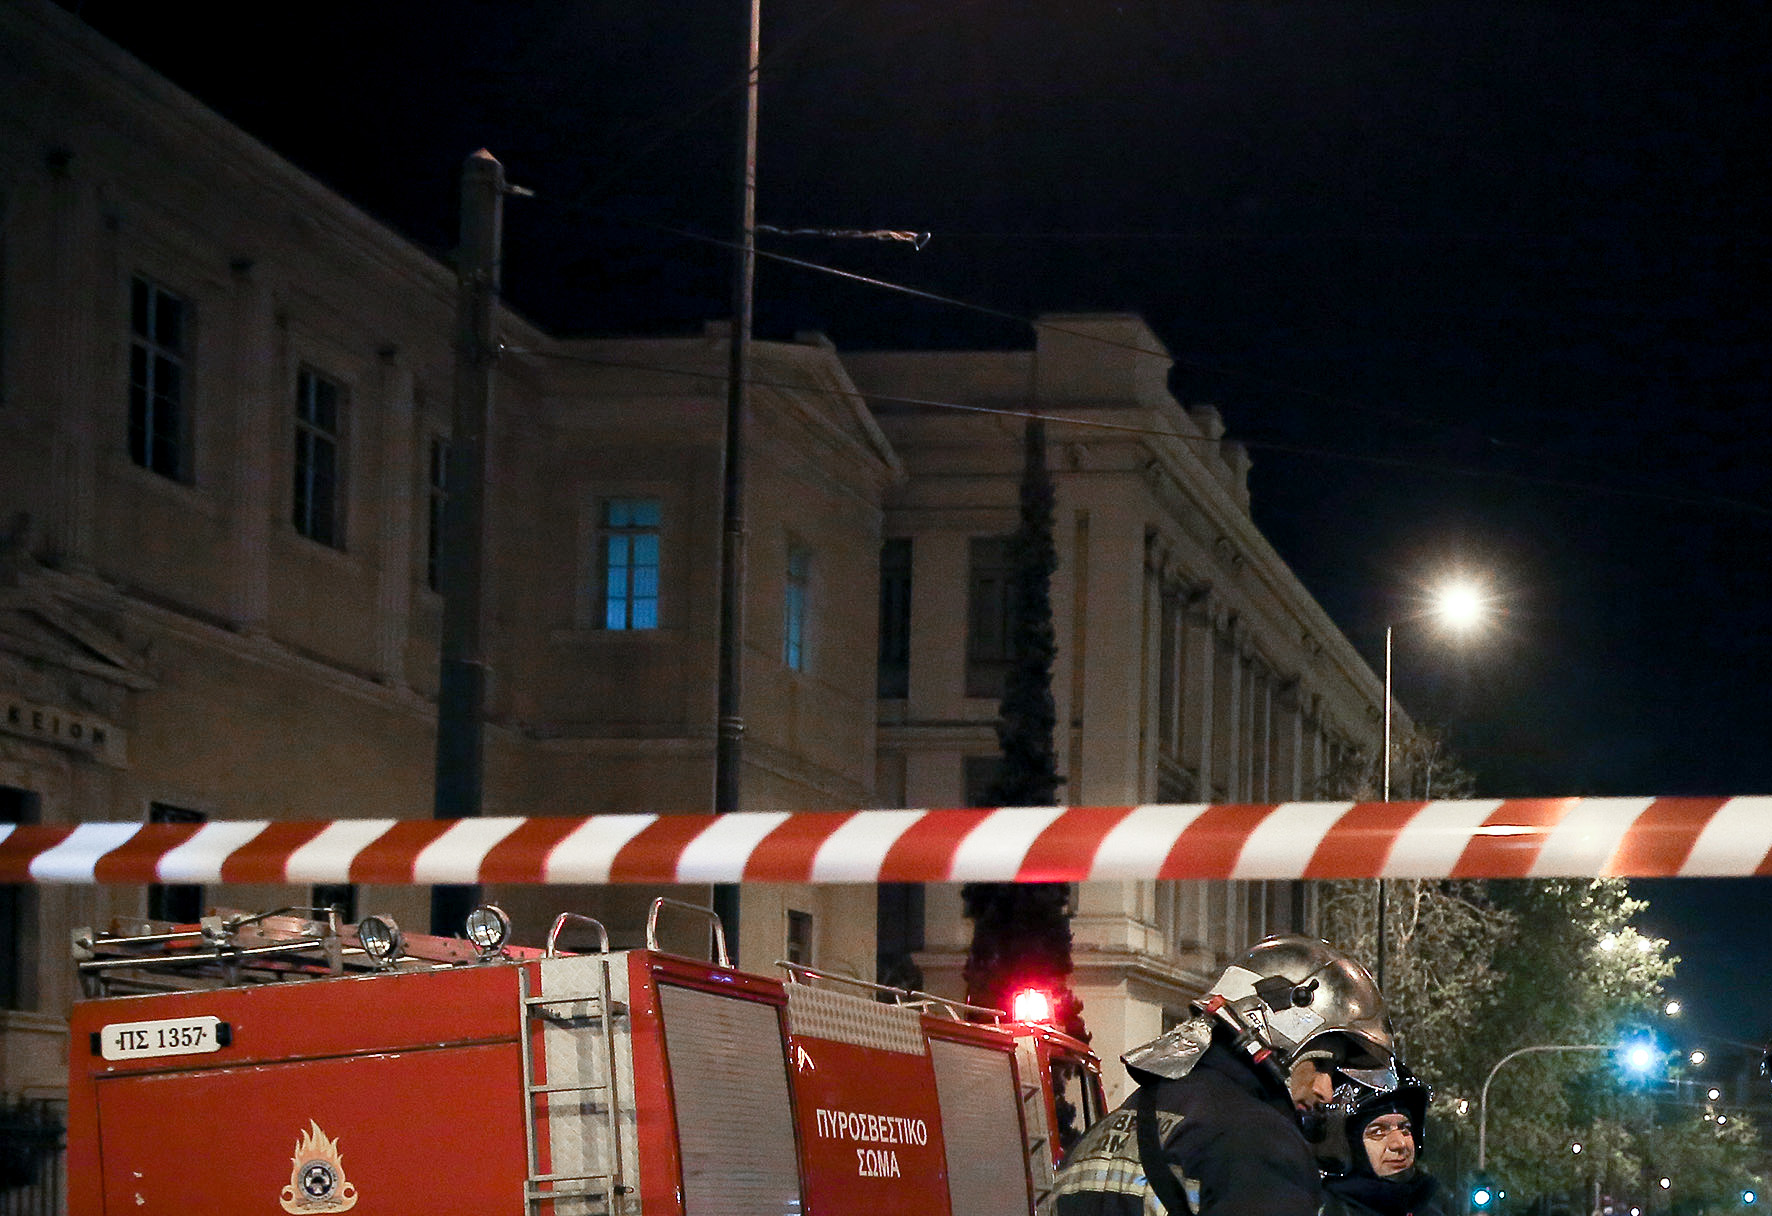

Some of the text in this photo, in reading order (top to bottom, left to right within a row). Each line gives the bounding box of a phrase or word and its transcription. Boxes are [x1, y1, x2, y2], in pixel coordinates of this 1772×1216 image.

[120, 1027, 202, 1050] ΠΣ 1357
[816, 1108, 928, 1146] ΠΥΡΟΣΒΕΣΤΙΚΟ
[856, 1149, 901, 1178] ΣΩΜΑ
